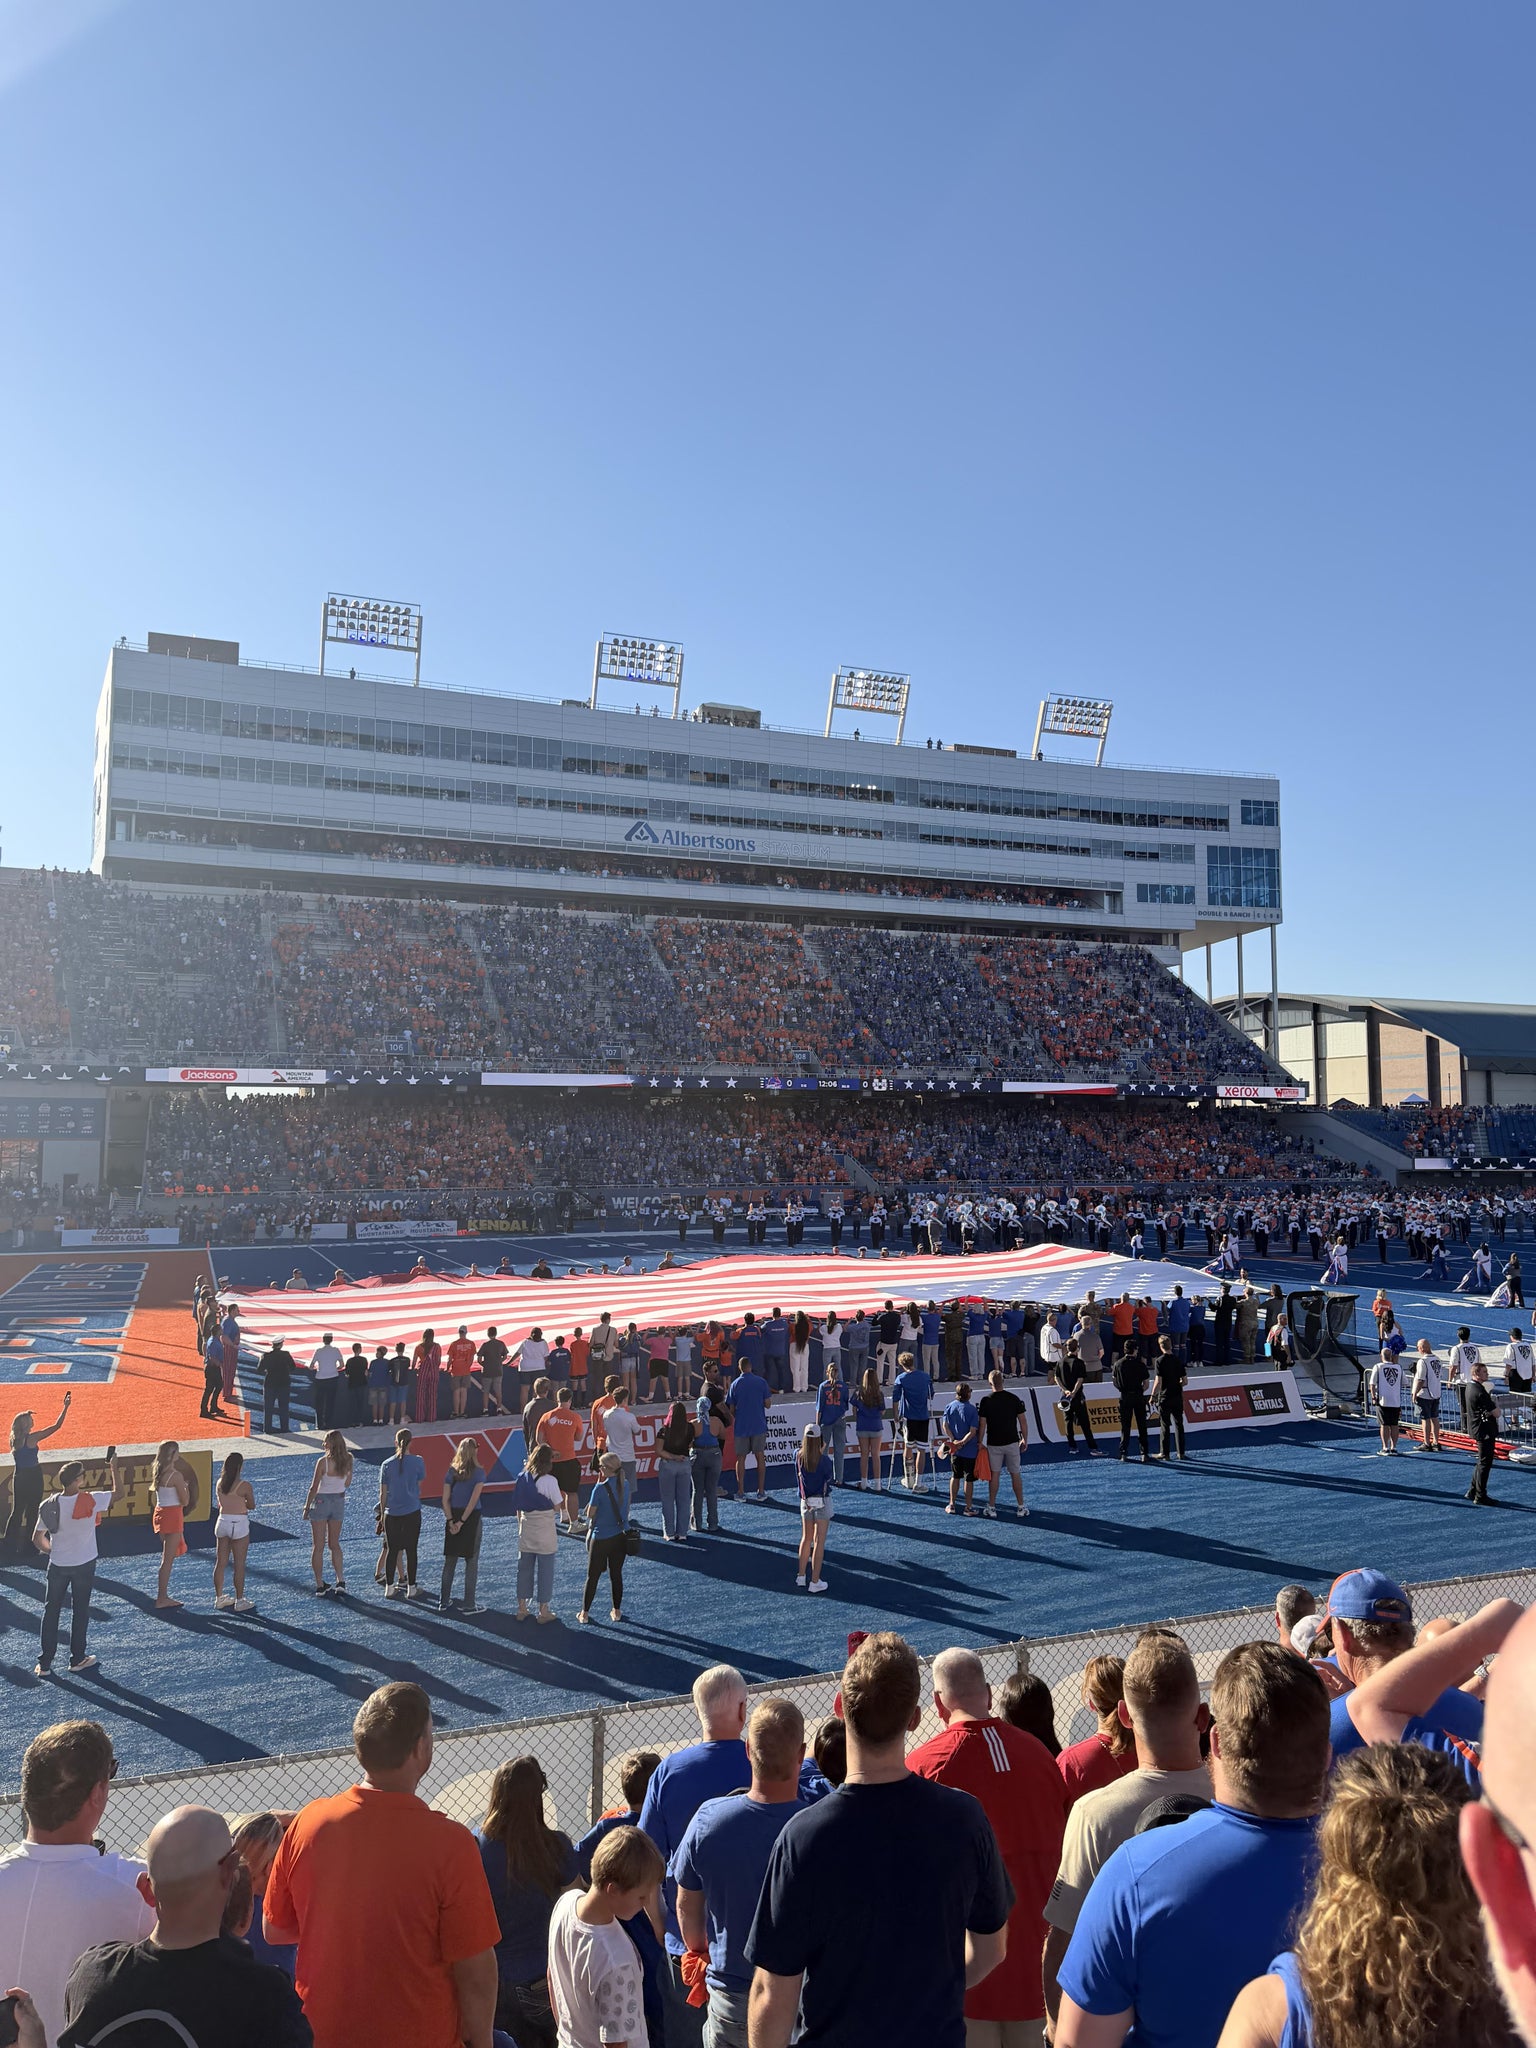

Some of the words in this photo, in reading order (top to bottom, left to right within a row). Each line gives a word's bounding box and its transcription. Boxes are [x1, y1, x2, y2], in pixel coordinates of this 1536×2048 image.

[662, 829, 756, 852] Albertsons
[761, 841, 830, 858] STADIUM
[390, 1043, 404, 1051] 106
[184, 1069, 235, 1080] jacksons
[786, 1079, 793, 1087] 0
[818, 1080, 838, 1088] 12:06
[862, 1080, 869, 1088] 0
[1224, 1086, 1259, 1097] xerox
[467, 1219, 539, 1232] KENDAL
[1205, 1394, 1240, 1405] WESTERN
[1249, 1389, 1264, 1400] CAT
[1206, 1403, 1232, 1412] STATES
[1253, 1398, 1284, 1411] RENTALS
[1089, 1406, 1120, 1415] WESTE
[778, 1440, 788, 1450] OF
[788, 1440, 802, 1449] THE
